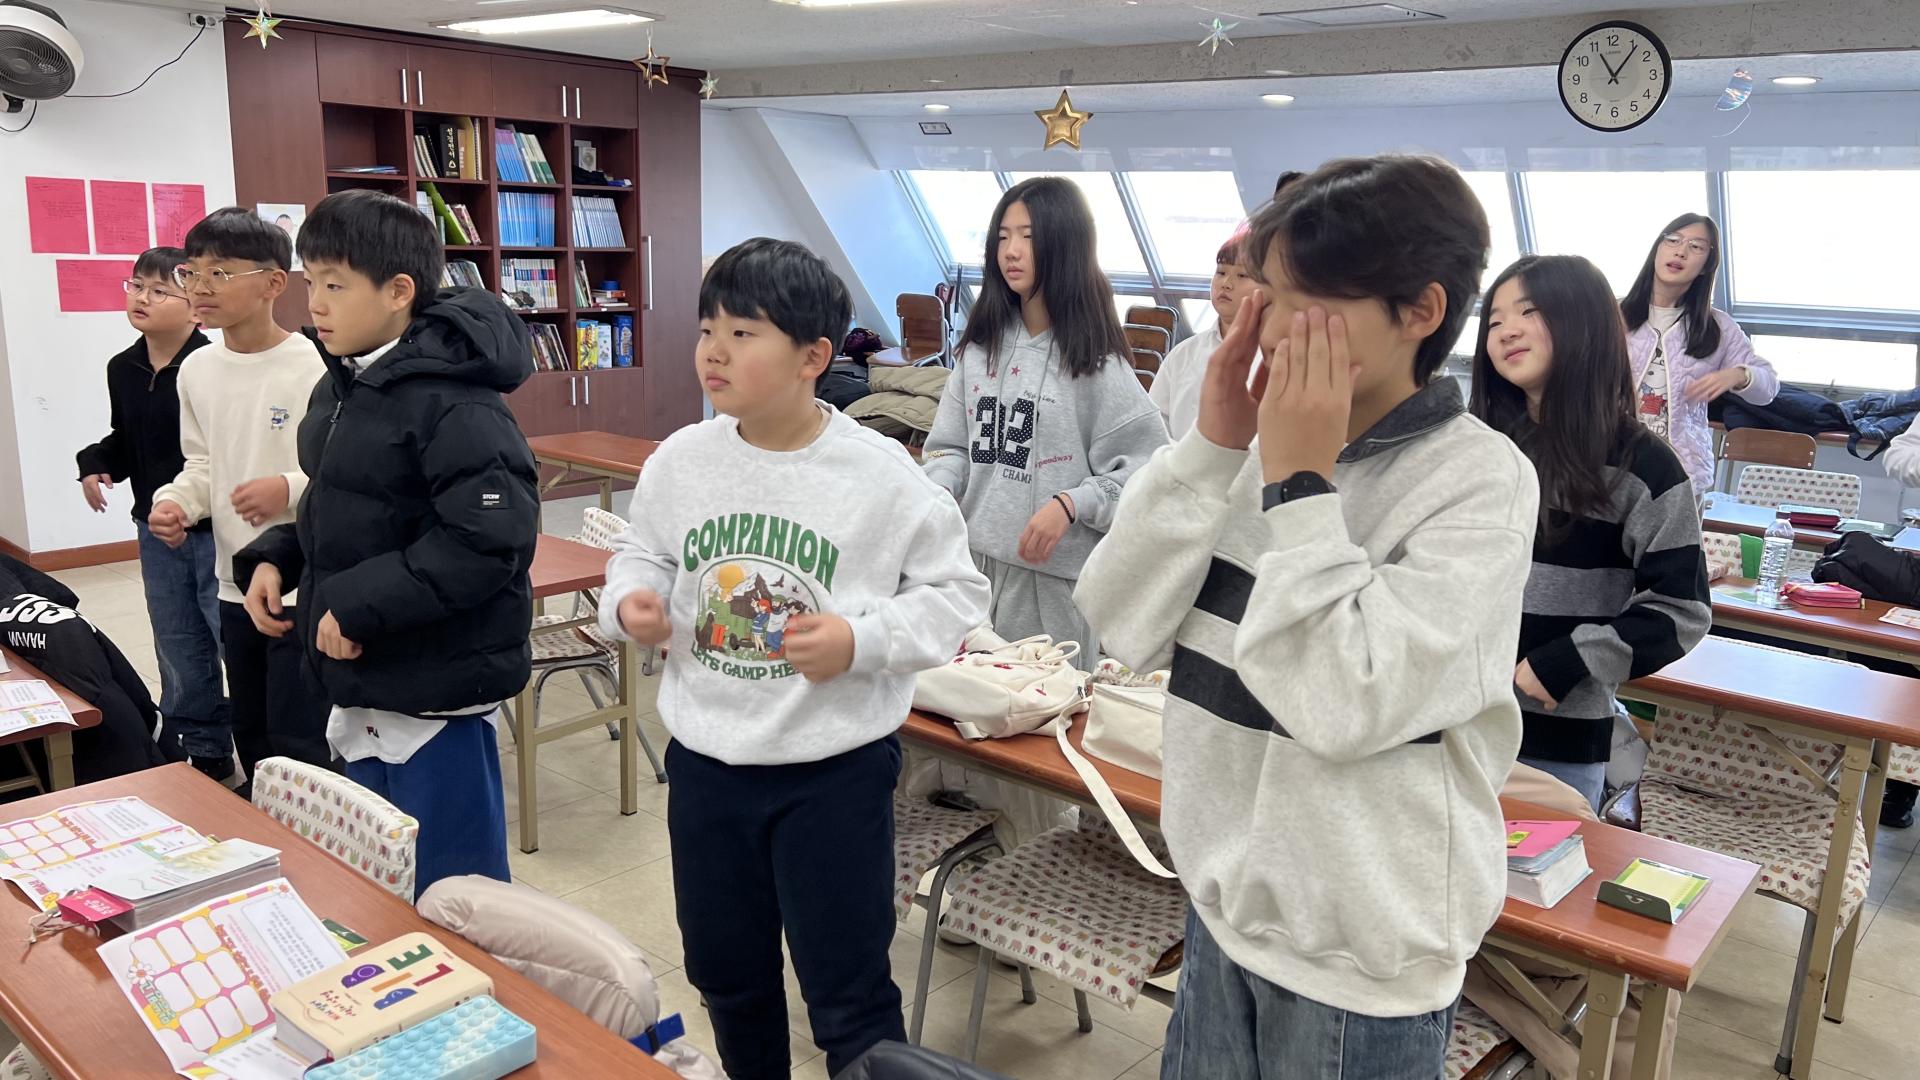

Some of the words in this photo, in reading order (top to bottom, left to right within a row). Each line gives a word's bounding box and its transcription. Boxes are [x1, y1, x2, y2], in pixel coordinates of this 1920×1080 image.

[1606, 35, 1619, 46] 12
[1629, 39, 1636, 49] 1
[1590, 41, 1599, 52] 11
[1576, 56, 1589, 67] 10
[1642, 51, 1651, 62] 2
[1572, 74, 1580, 85] 9
[1649, 69, 1658, 80] 3
[1580, 93, 1588, 103] 8
[1643, 88, 1651, 99] 4
[1594, 104, 1601, 114] 7
[1630, 101, 1638, 111] 5
[1611, 107, 1619, 117] 6
[971, 396, 1039, 469] 32
[683, 513, 839, 595] COMPANION
[722, 661, 768, 680] CAMP
[770, 663, 799, 679] HE
